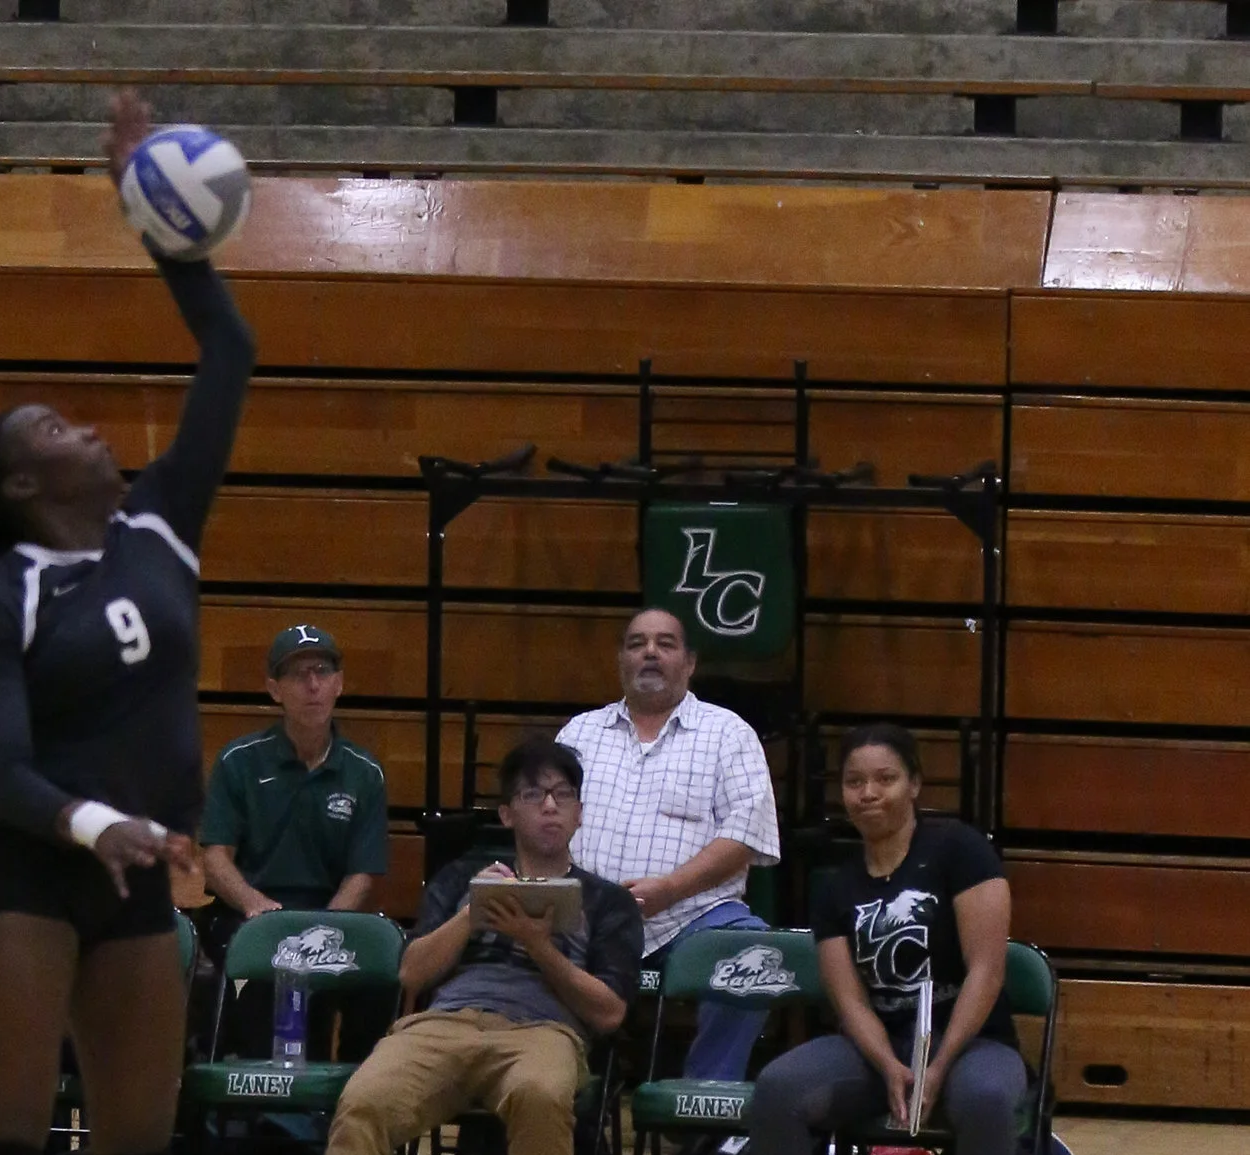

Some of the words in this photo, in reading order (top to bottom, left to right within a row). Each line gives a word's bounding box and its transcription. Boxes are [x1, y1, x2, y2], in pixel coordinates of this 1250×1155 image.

[106, 597, 151, 665] 9
[296, 625, 320, 644] L
[711, 964, 789, 991] Eagles
[227, 1074, 293, 1097] LANEY
[676, 1095, 744, 1119] LANEY
